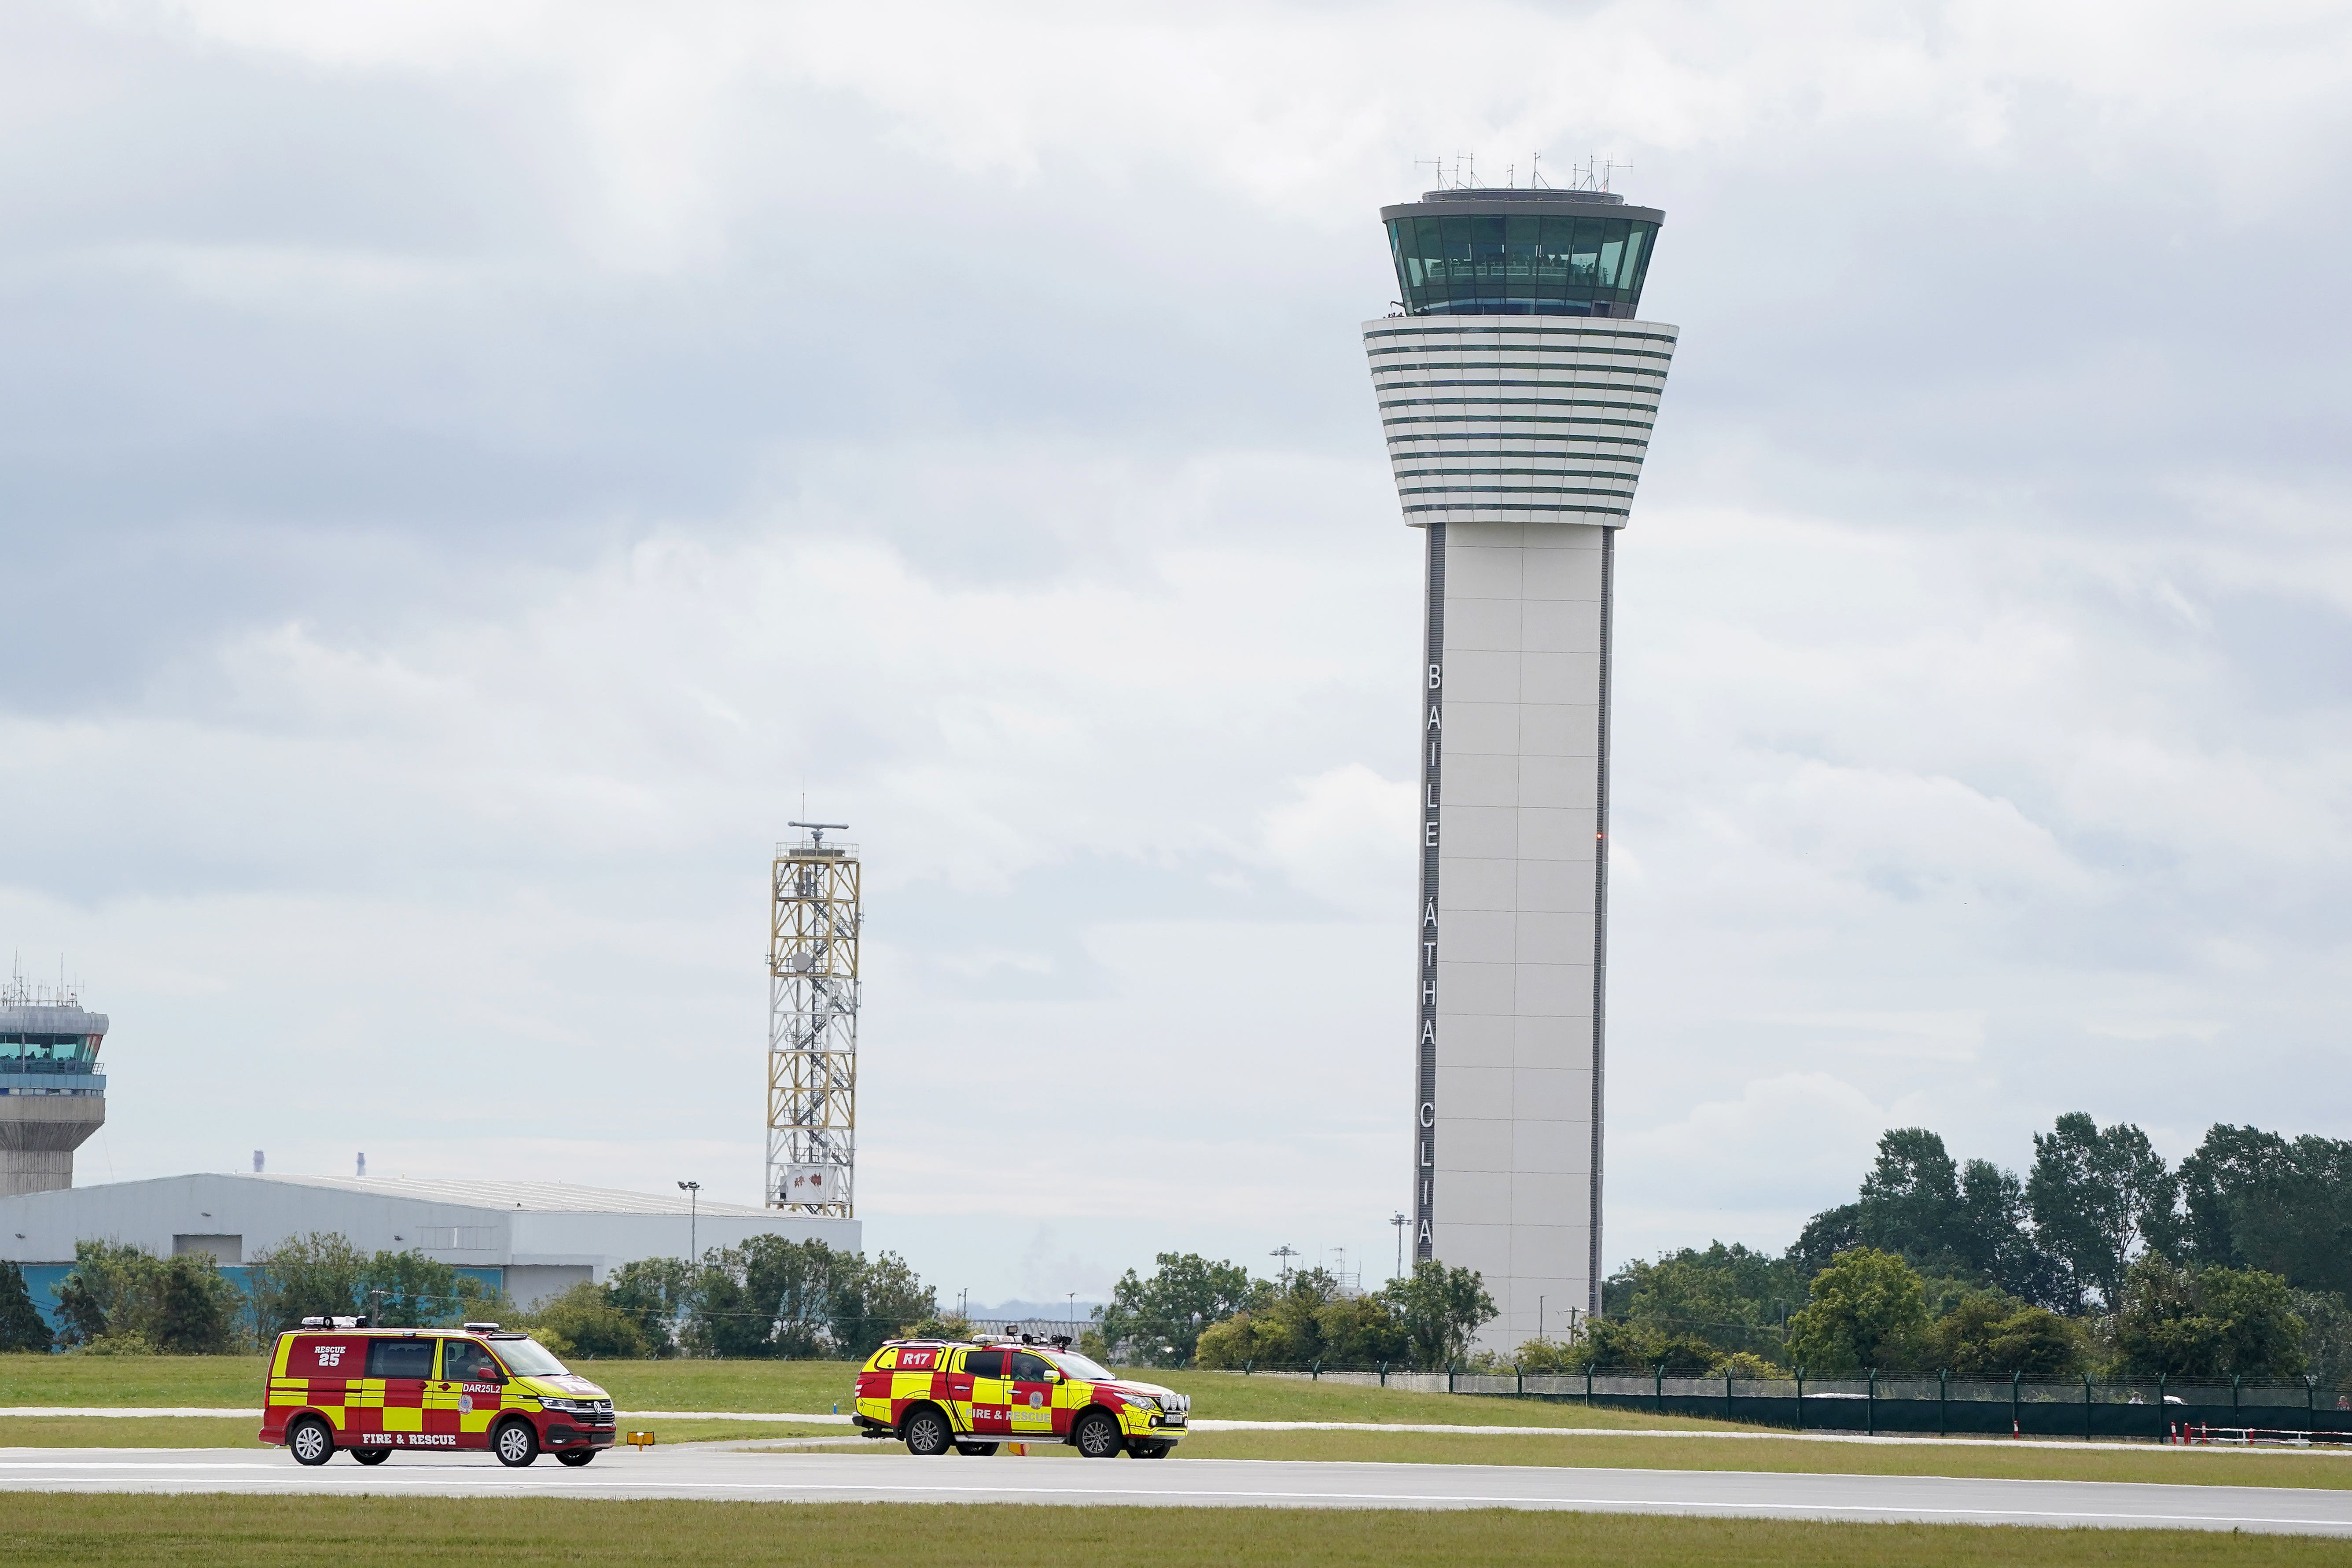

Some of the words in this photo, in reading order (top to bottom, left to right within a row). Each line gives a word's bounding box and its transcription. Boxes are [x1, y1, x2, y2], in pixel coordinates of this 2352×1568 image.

[1425, 664, 1441, 847] BAILE
[1421, 896, 1437, 1044] ÁTHA
[318, 1353, 340, 1366] 25
[903, 1353, 930, 1365] R17
[463, 1384, 501, 1393] DAR25L2
[965, 1408, 991, 1419] FIRE
[994, 1410, 1002, 1420] &
[1005, 1411, 1051, 1422] RESCUE
[362, 1434, 392, 1444] FIRE
[397, 1434, 405, 1444] &
[409, 1435, 456, 1445] RESCUE
